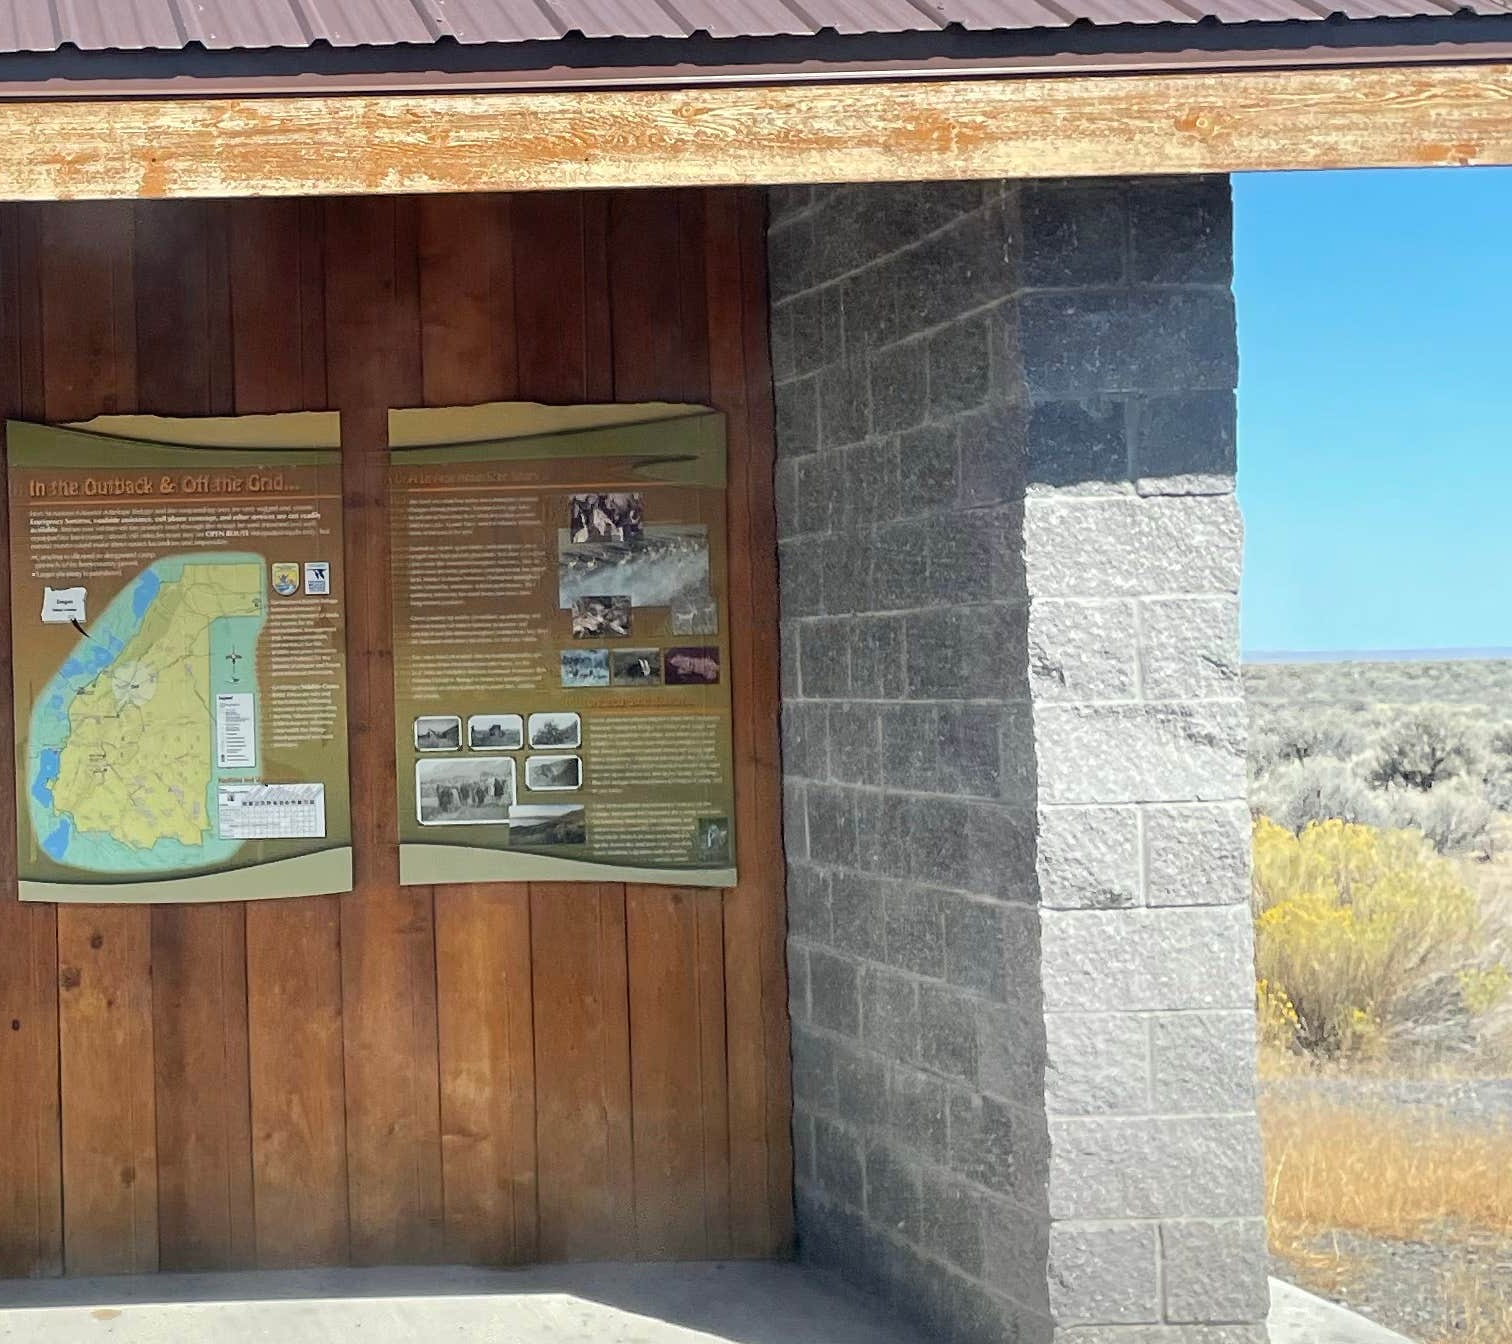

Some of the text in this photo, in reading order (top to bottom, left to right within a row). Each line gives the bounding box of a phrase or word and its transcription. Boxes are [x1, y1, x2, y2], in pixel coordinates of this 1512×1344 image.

[29, 479, 46, 496] In
[85, 476, 153, 496] Outback
[159, 476, 178, 494] &
[183, 474, 209, 493] Off
